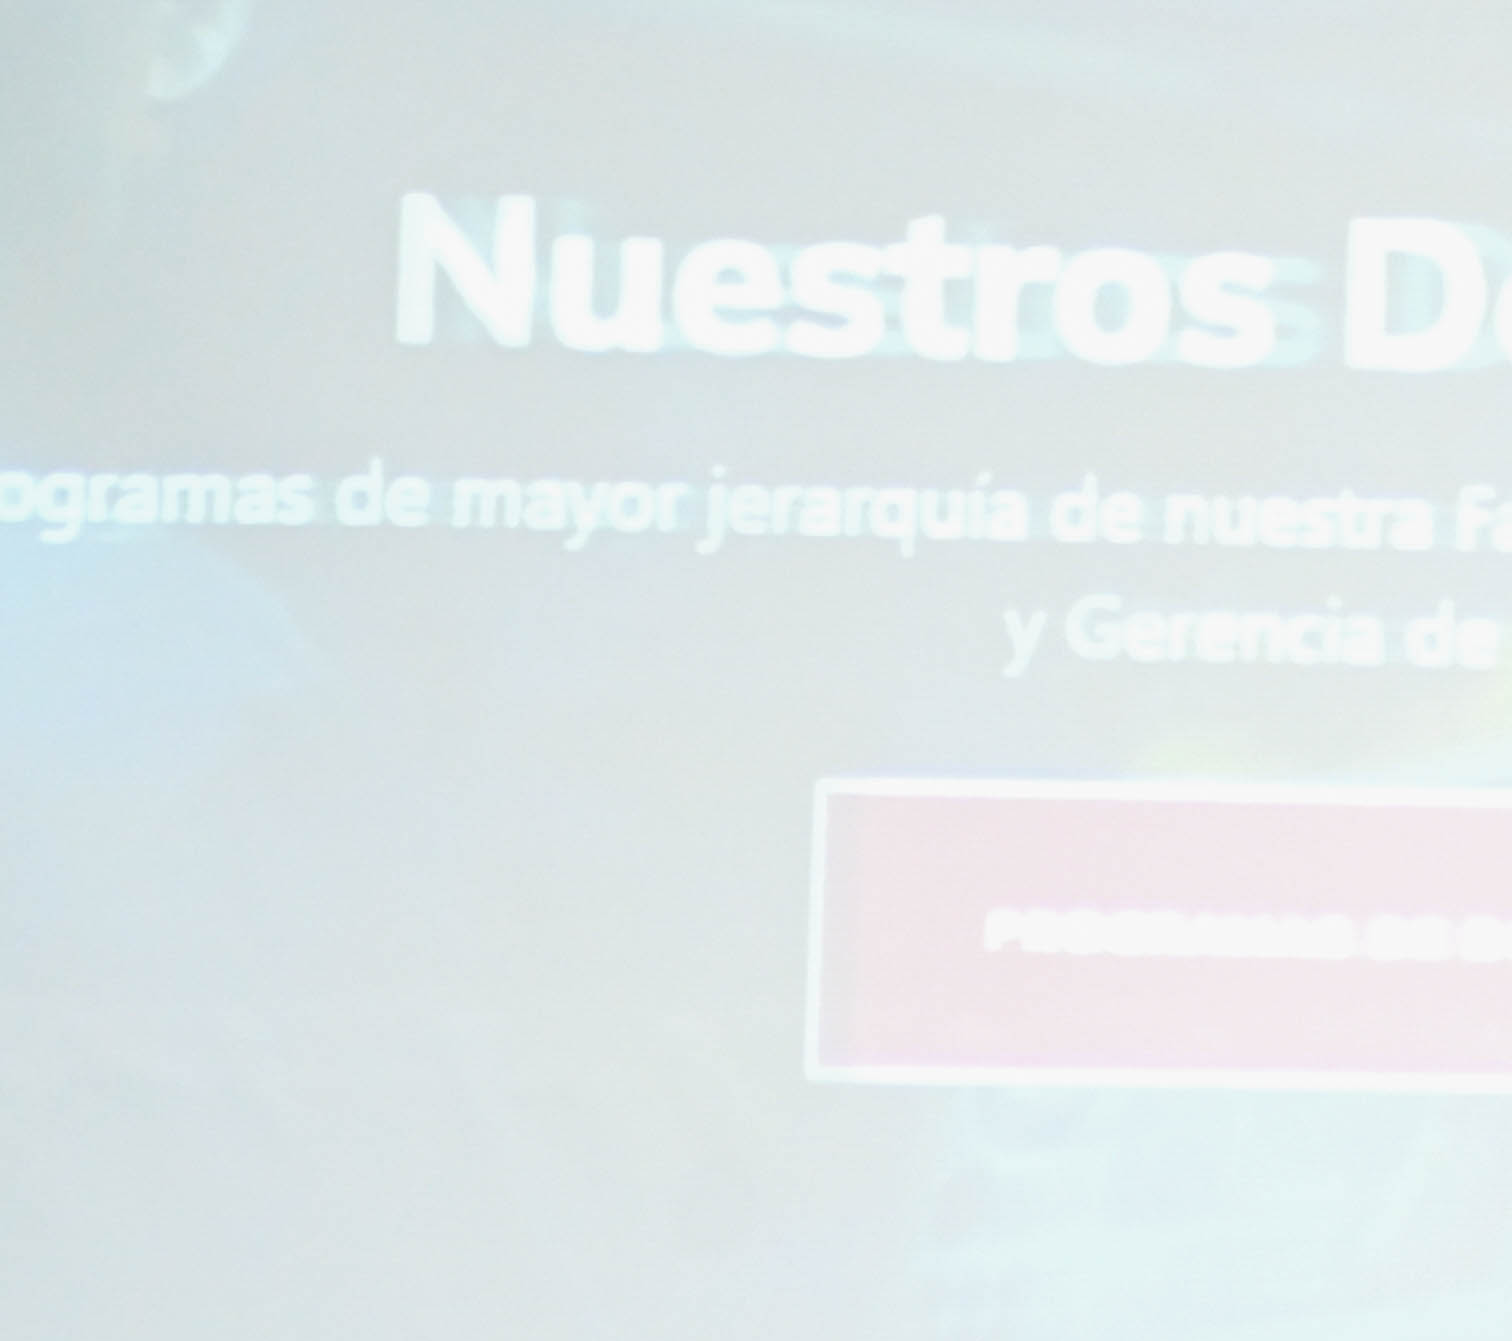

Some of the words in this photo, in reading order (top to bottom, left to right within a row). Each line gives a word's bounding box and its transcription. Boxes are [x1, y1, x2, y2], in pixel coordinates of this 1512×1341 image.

[396, 190, 1278, 367] Nuestros
[336, 456, 429, 527] de
[452, 474, 691, 550] mayor
[694, 464, 1028, 558] jerarquía
[1050, 473, 1142, 544] de
[1164, 486, 1434, 552] nuestra
[1002, 602, 1048, 678] y
[1062, 590, 1385, 668] Gerencia
[1405, 597, 1501, 670] de
